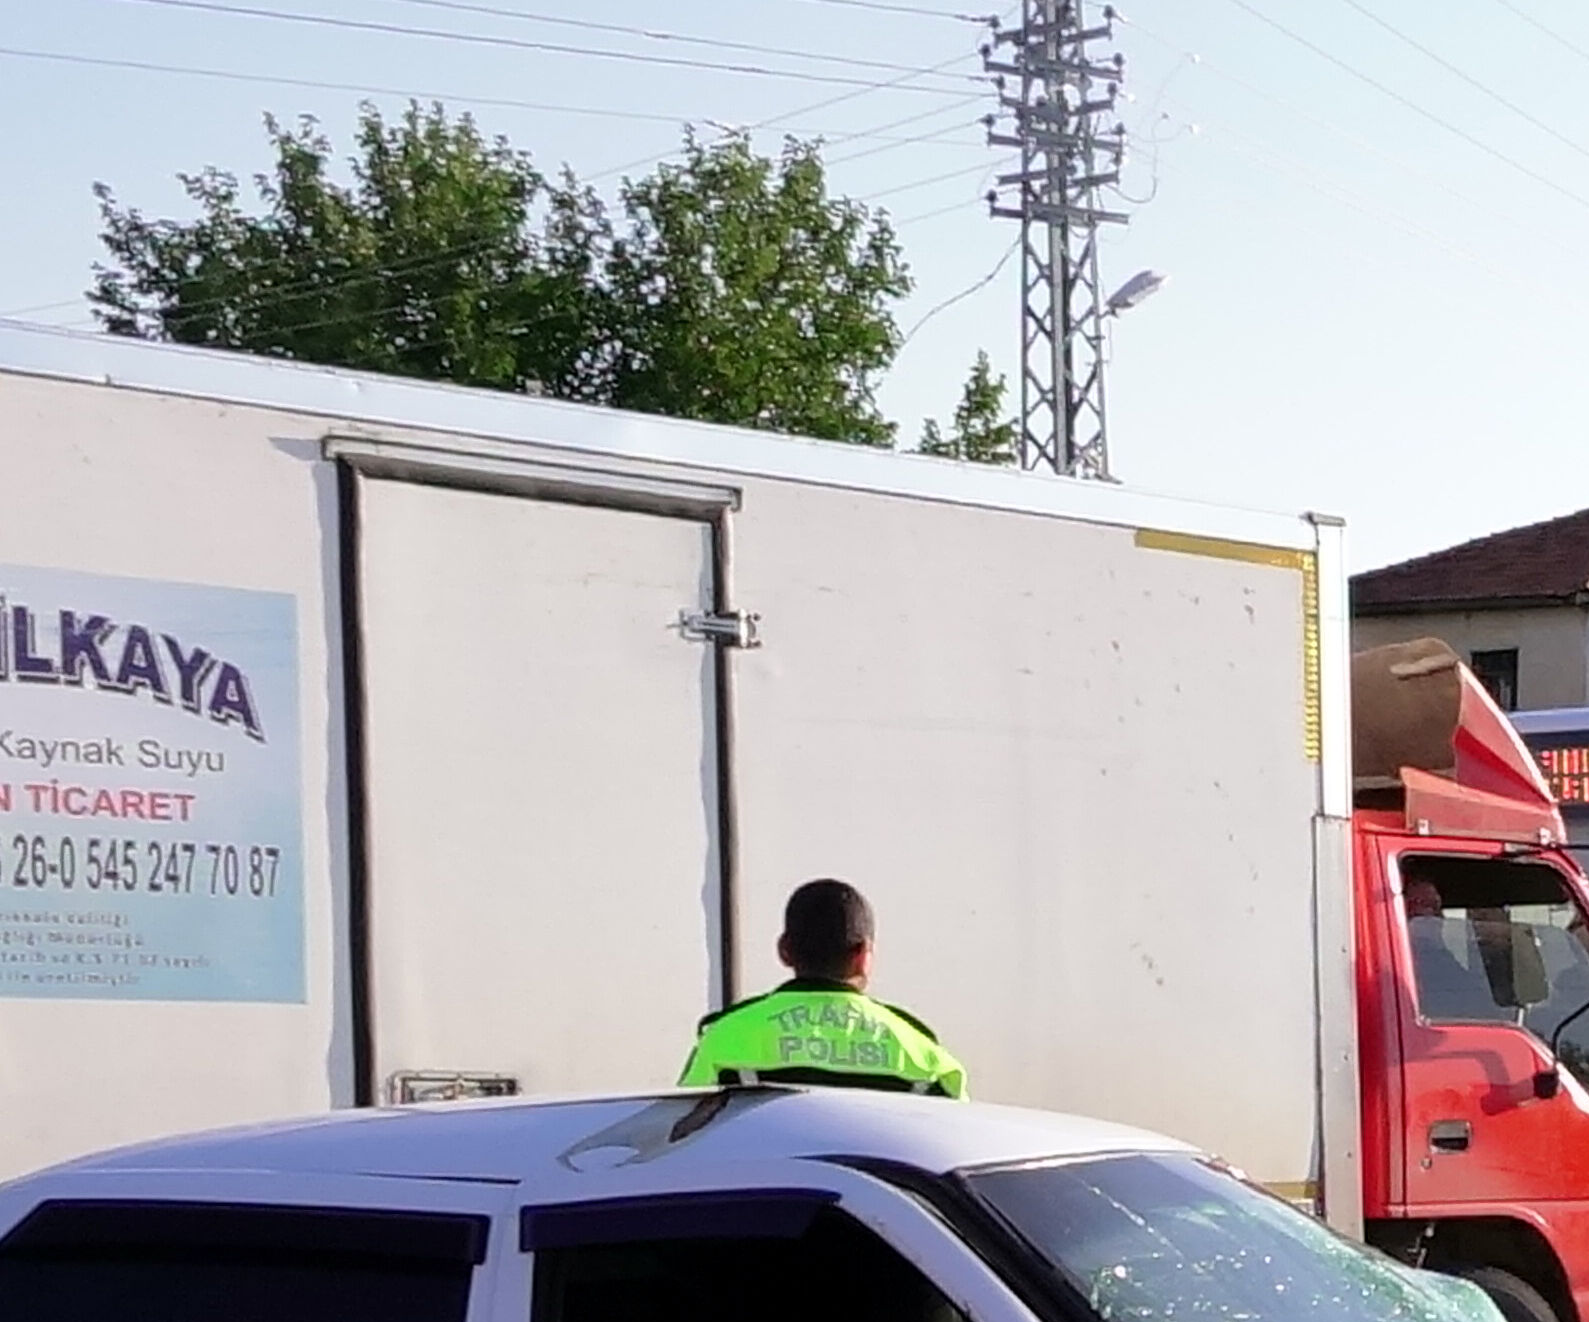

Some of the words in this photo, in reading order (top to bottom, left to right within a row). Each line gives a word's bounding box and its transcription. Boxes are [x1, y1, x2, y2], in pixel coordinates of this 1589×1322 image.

[0, 592, 267, 743] LKAYA
[138, 739, 225, 777] Suyu
[24, 778, 196, 822] TİCARET
[12, 833, 76, 889] 26-0
[86, 837, 138, 892] 545
[147, 840, 196, 893] 247
[205, 843, 239, 896] 70
[249, 846, 280, 898] 87
